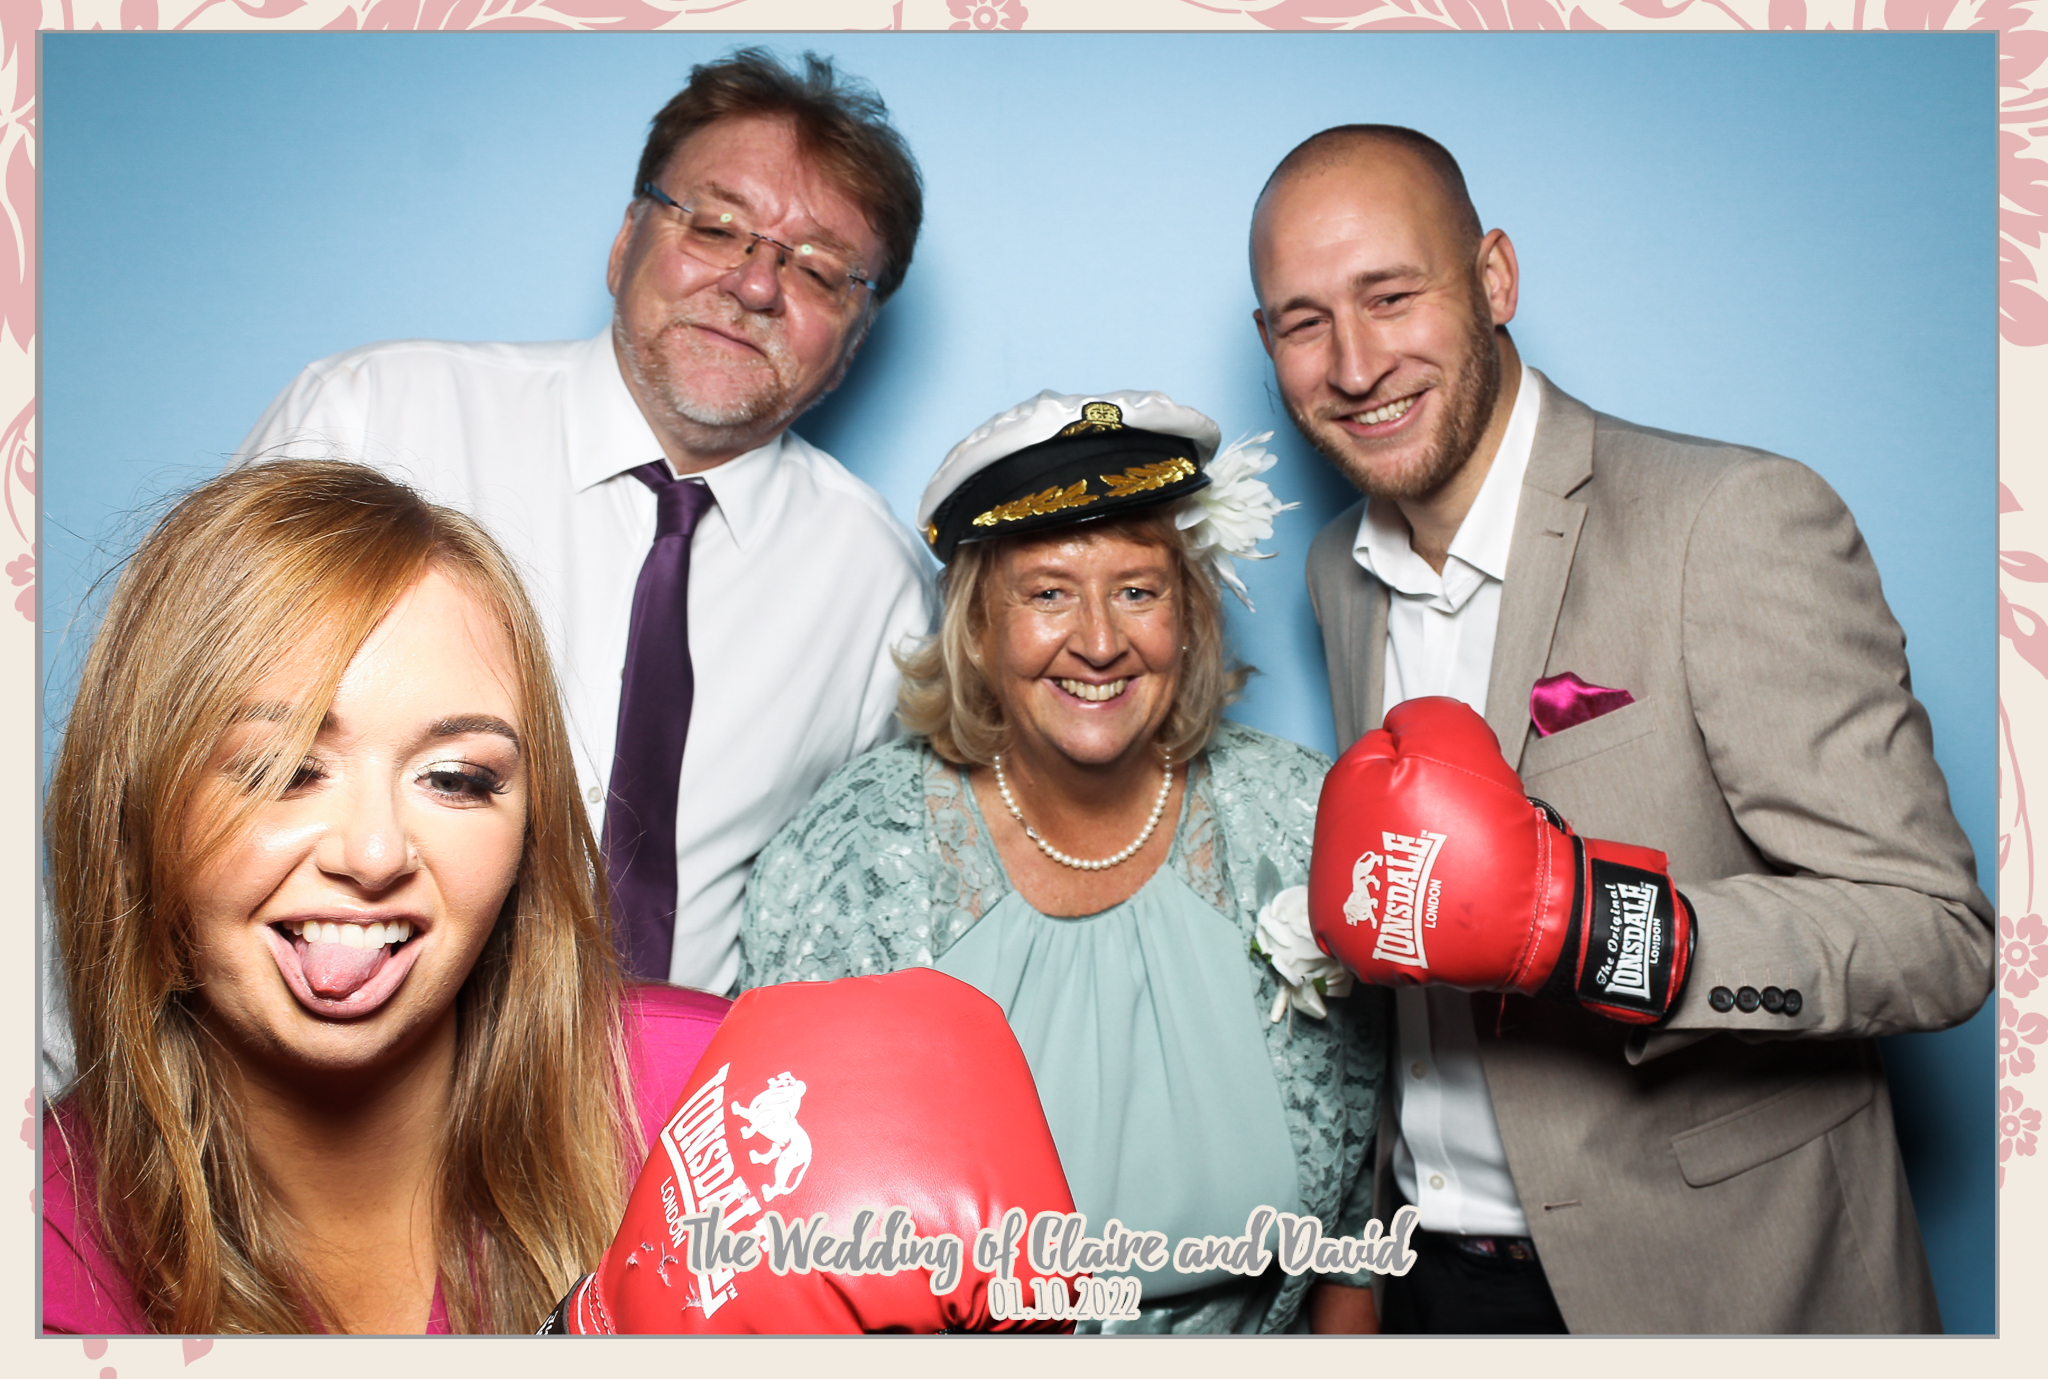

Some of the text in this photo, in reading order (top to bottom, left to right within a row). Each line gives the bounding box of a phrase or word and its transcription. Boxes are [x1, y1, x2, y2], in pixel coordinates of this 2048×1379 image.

[1371, 830, 1447, 969] LONSDALE
[1425, 879, 1442, 928] LONDON
[1596, 883, 1623, 985] The Original
[1604, 882, 1659, 999] LONSDALE
[1650, 917, 1661, 965] LONDON
[660, 1175, 687, 1249] LONDON
